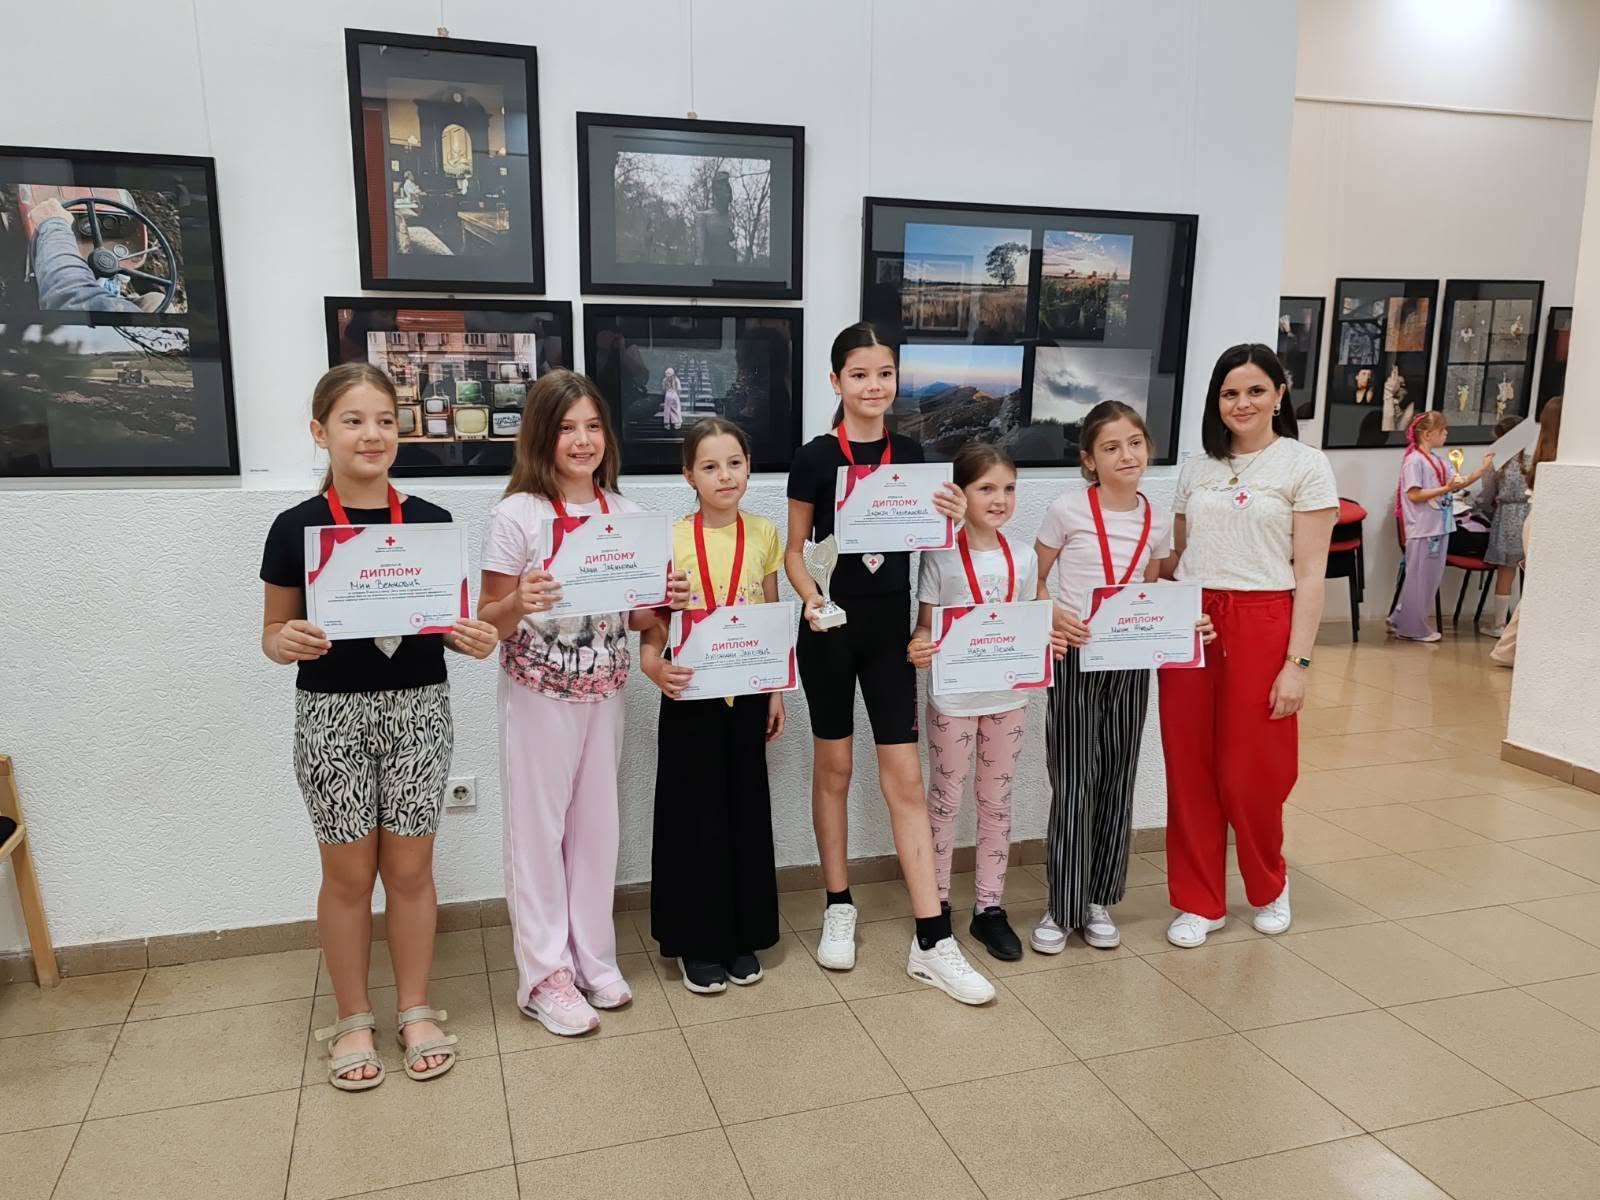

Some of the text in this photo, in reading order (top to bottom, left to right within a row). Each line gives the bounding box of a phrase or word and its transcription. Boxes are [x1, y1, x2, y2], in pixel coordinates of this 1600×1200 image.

[872, 499, 918, 508] ДИПЛОМУ
[585, 552, 635, 564] ДИПЛОМУ
[360, 567, 422, 579] ДИПЛОМУ
[1118, 615, 1164, 625] ДИПЛОМУ
[712, 639, 759, 651] ДИПЛОМУ
[970, 635, 1016, 647] ДИПЛОМУ
